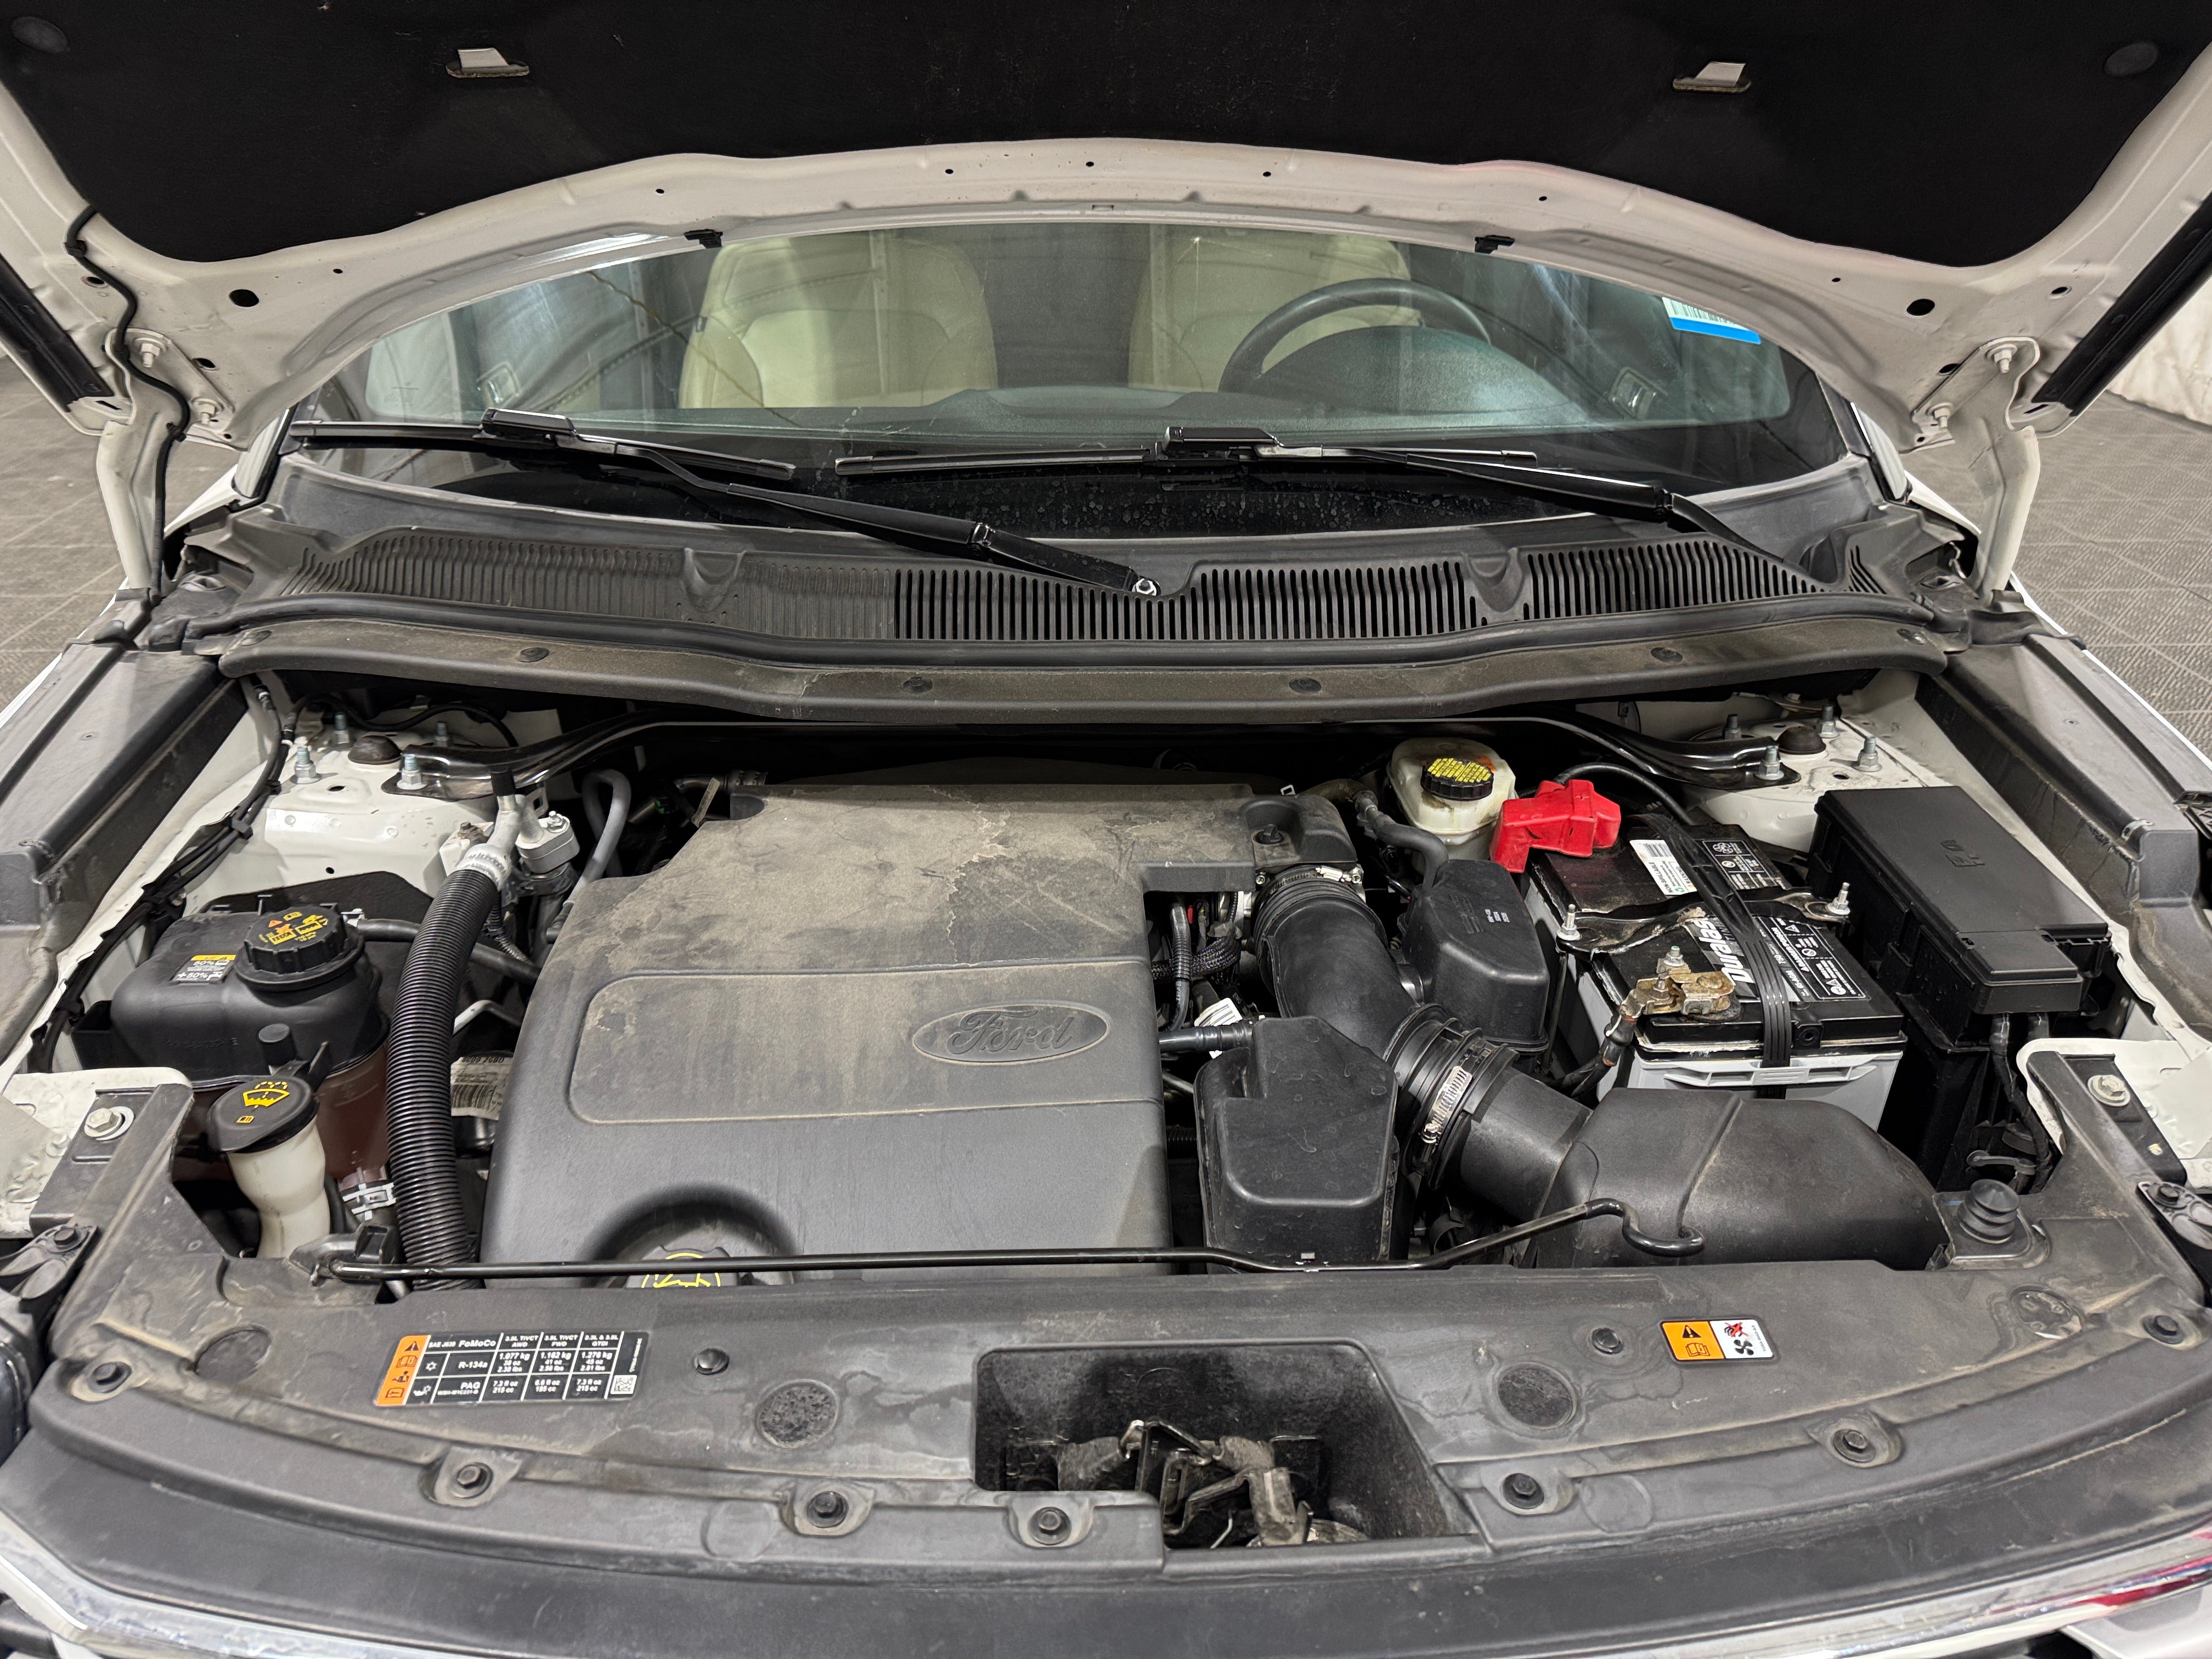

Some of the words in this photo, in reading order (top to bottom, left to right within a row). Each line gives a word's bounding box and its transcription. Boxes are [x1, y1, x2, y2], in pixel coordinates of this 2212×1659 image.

[946, 1009, 1075, 1055] Ford
[459, 1339, 496, 1347] FoMoCo
[520, 1352, 530, 1361] kg
[561, 1352, 572, 1360] kg
[602, 1351, 613, 1360] kg
[460, 1381, 481, 1390] PAG
